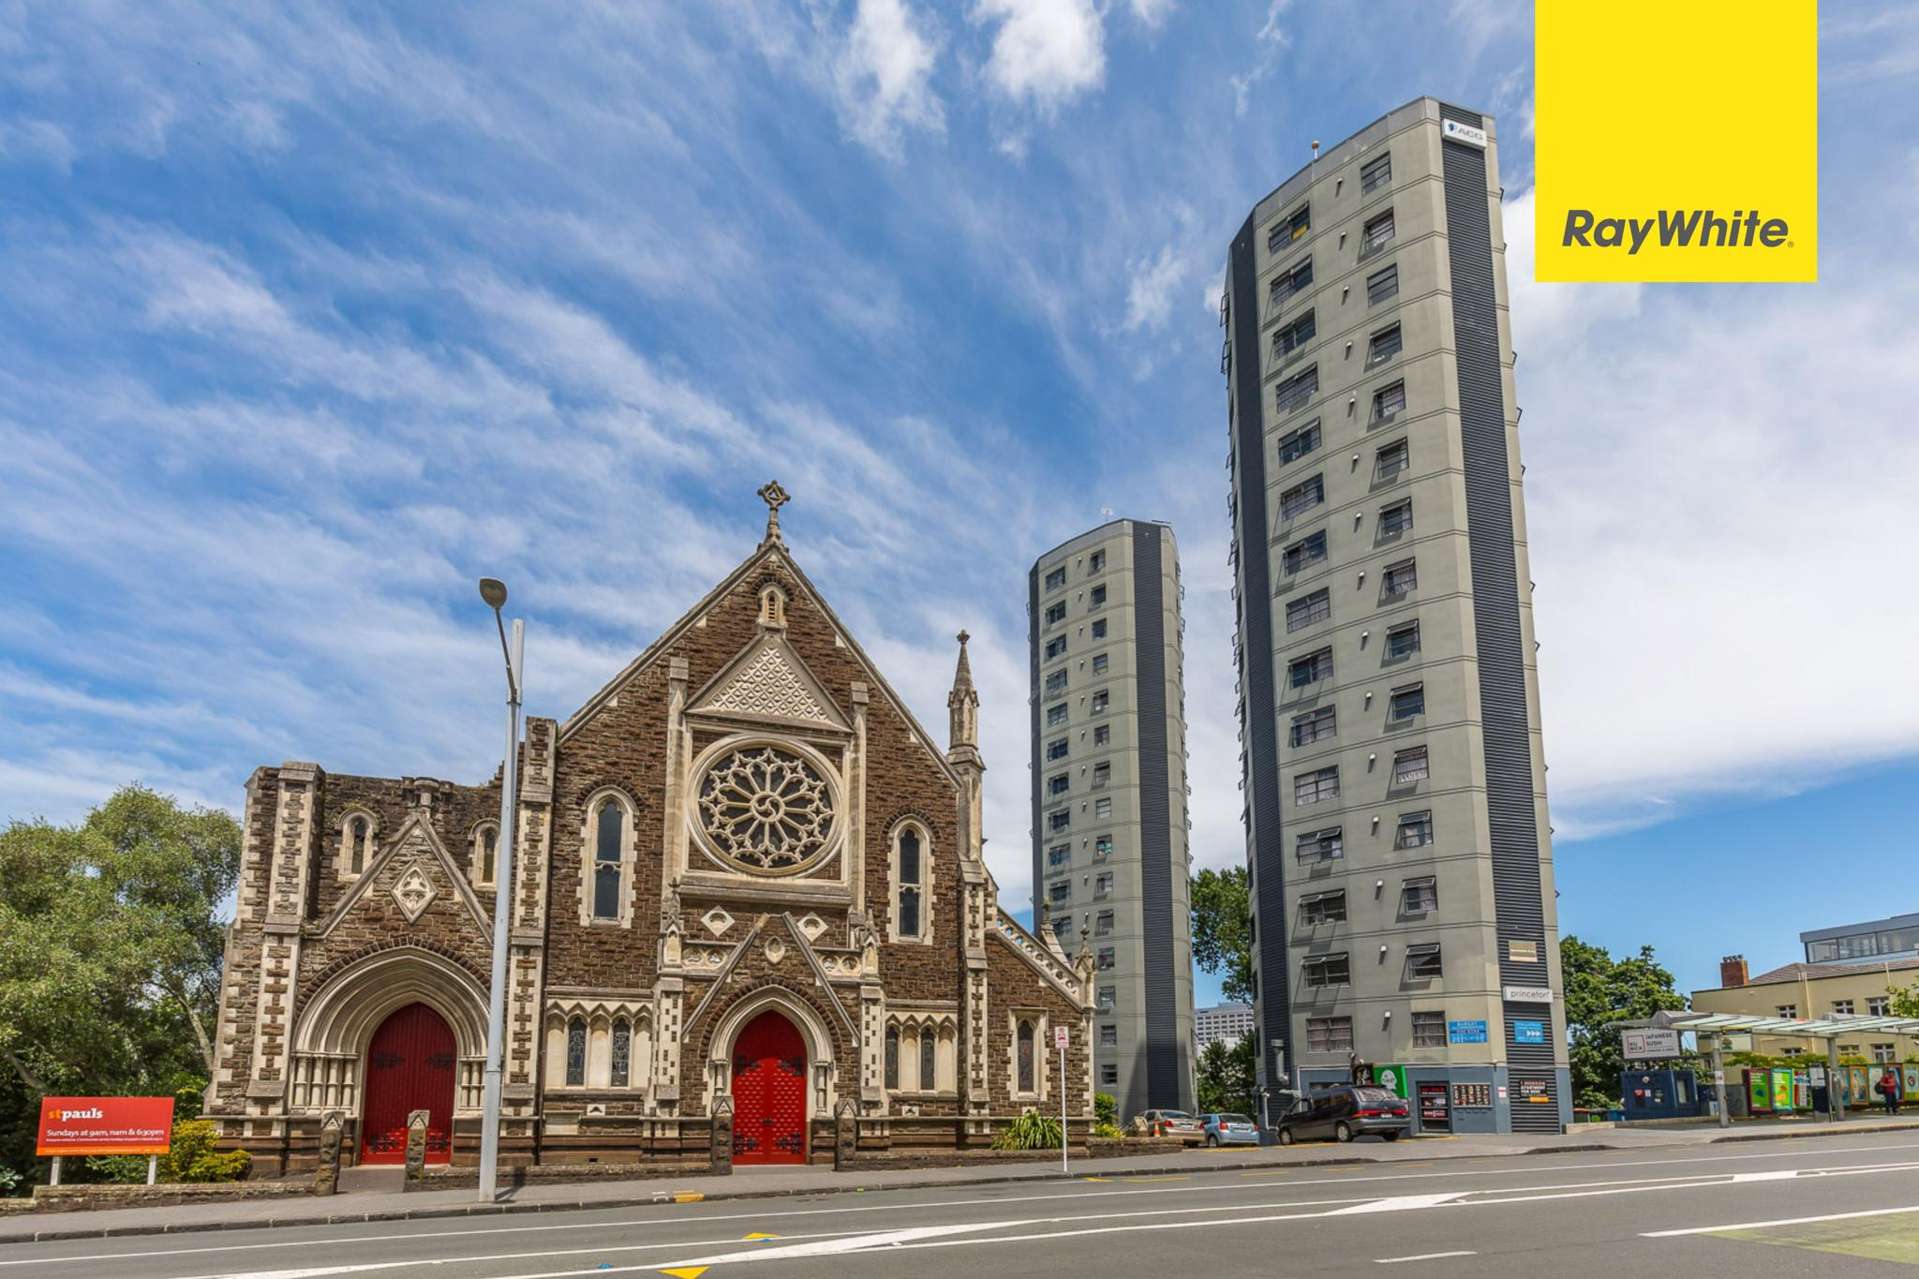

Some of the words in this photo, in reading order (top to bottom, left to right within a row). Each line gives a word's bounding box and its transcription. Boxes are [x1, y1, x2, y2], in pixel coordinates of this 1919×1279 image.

[1510, 989, 1550, 999] princeton
[47, 1129, 79, 1137] Sundays
[128, 1128, 135, 1136] &
